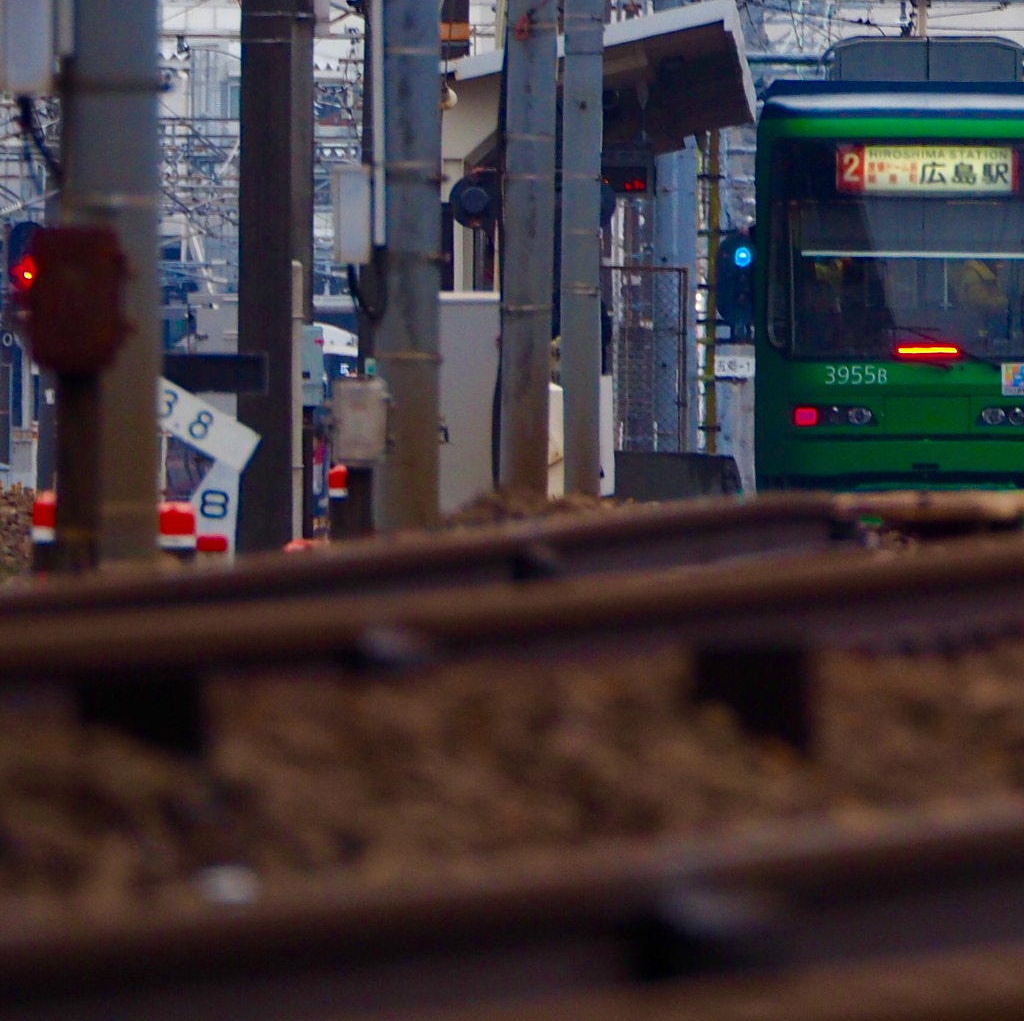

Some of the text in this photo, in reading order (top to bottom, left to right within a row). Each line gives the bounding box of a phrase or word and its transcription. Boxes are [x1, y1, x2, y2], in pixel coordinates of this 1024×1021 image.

[868, 147, 1008, 159] HIROSHIMA STATION
[843, 152, 860, 182] 2
[919, 161, 1009, 185] 広島駅
[825, 366, 888, 385] 3955B
[200, 489, 230, 519] 8
